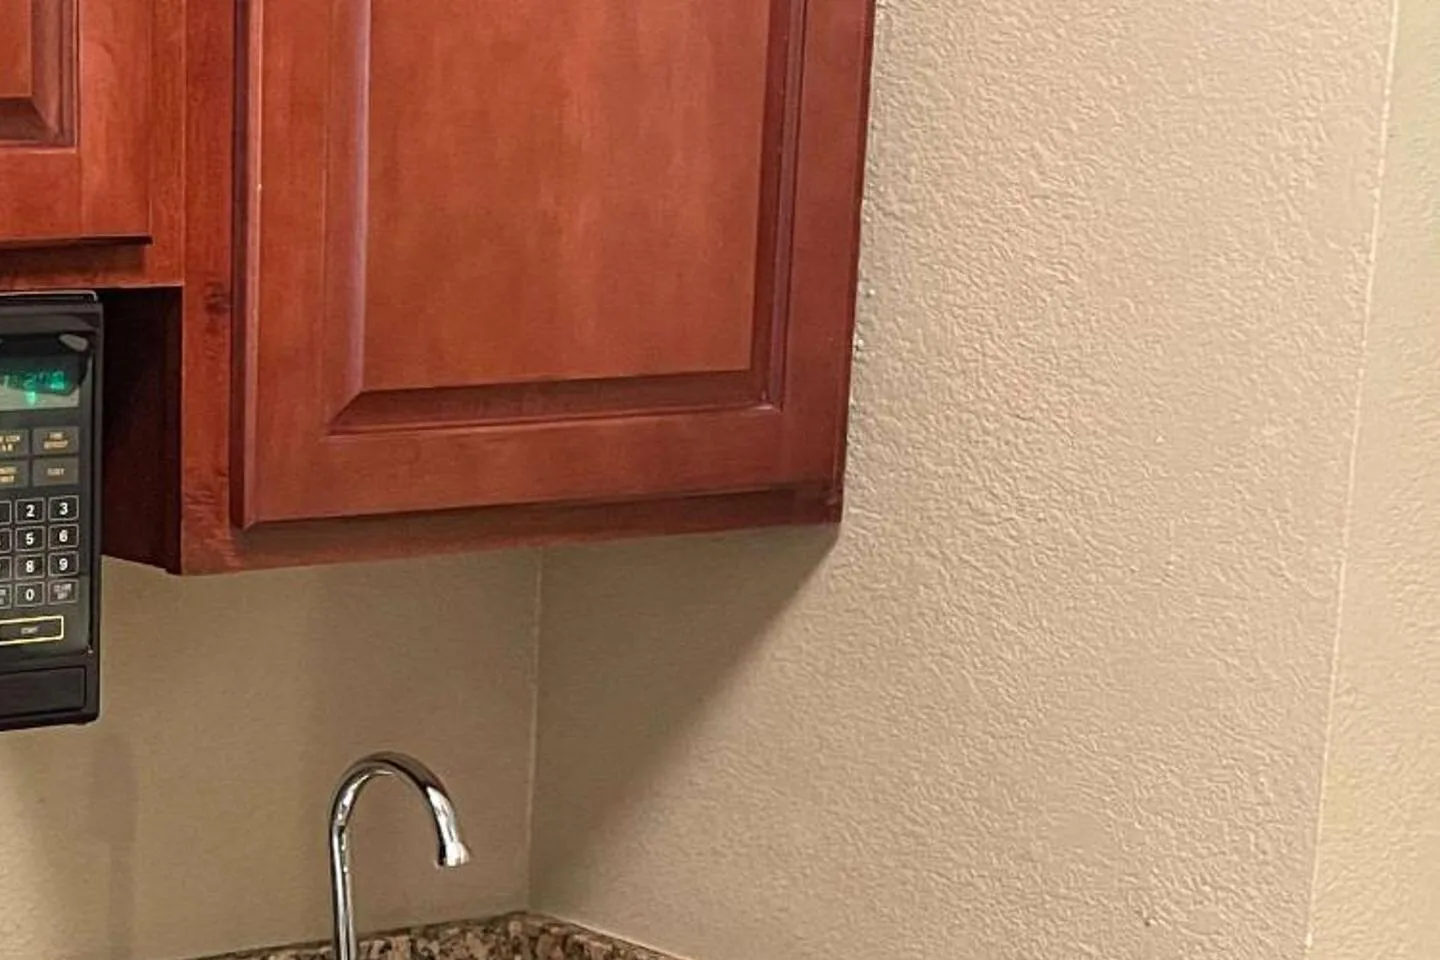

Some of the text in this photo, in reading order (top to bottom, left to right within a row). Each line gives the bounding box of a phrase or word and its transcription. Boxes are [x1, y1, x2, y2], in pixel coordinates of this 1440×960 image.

[26, 504, 35, 518] 2
[59, 502, 69, 515] 3
[26, 532, 35, 546] 5
[59, 529, 68, 543] 6
[26, 560, 35, 573] 8
[59, 558, 68, 571] 9
[25, 588, 35, 601] 0
